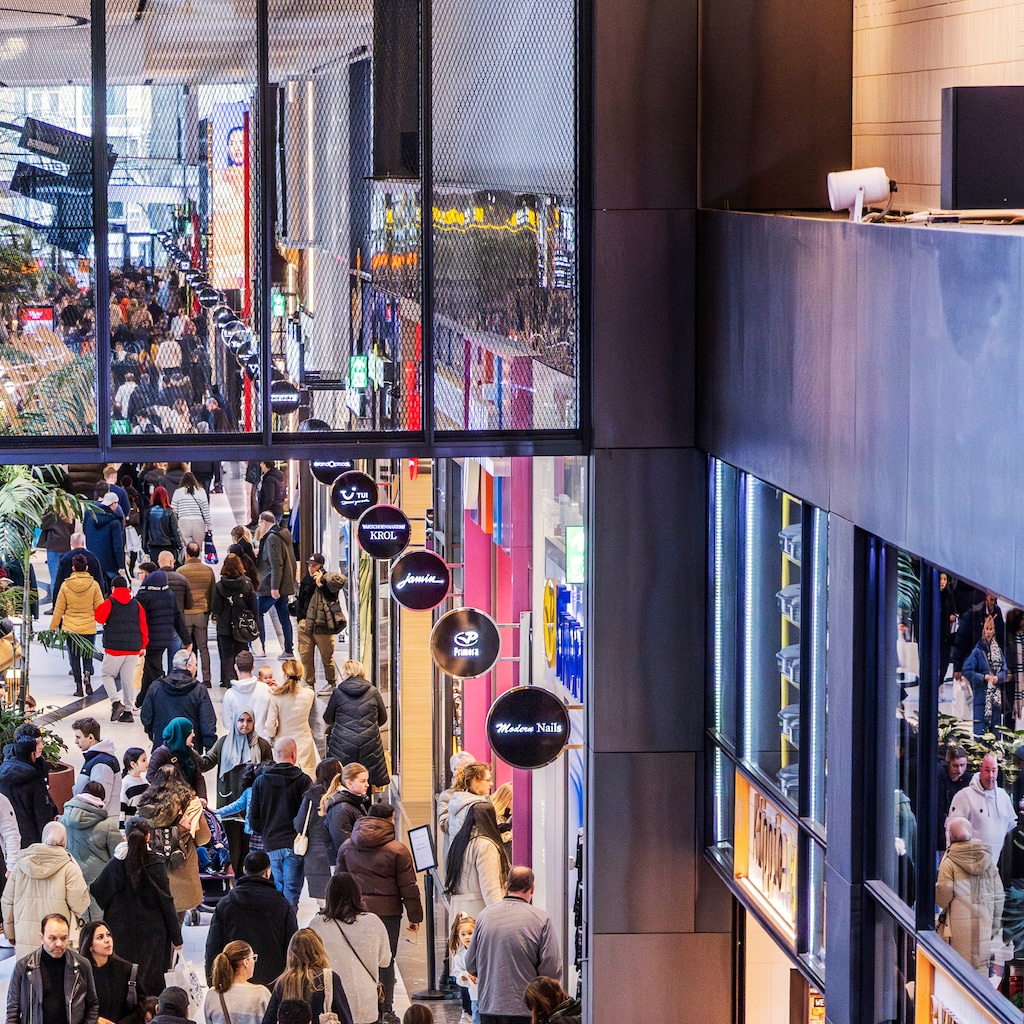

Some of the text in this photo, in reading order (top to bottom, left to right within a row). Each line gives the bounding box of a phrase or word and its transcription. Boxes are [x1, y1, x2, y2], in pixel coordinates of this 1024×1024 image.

[370, 531, 397, 540] KROL
[454, 647, 479, 656] Primera
[496, 722, 562, 734] Modern Nails
